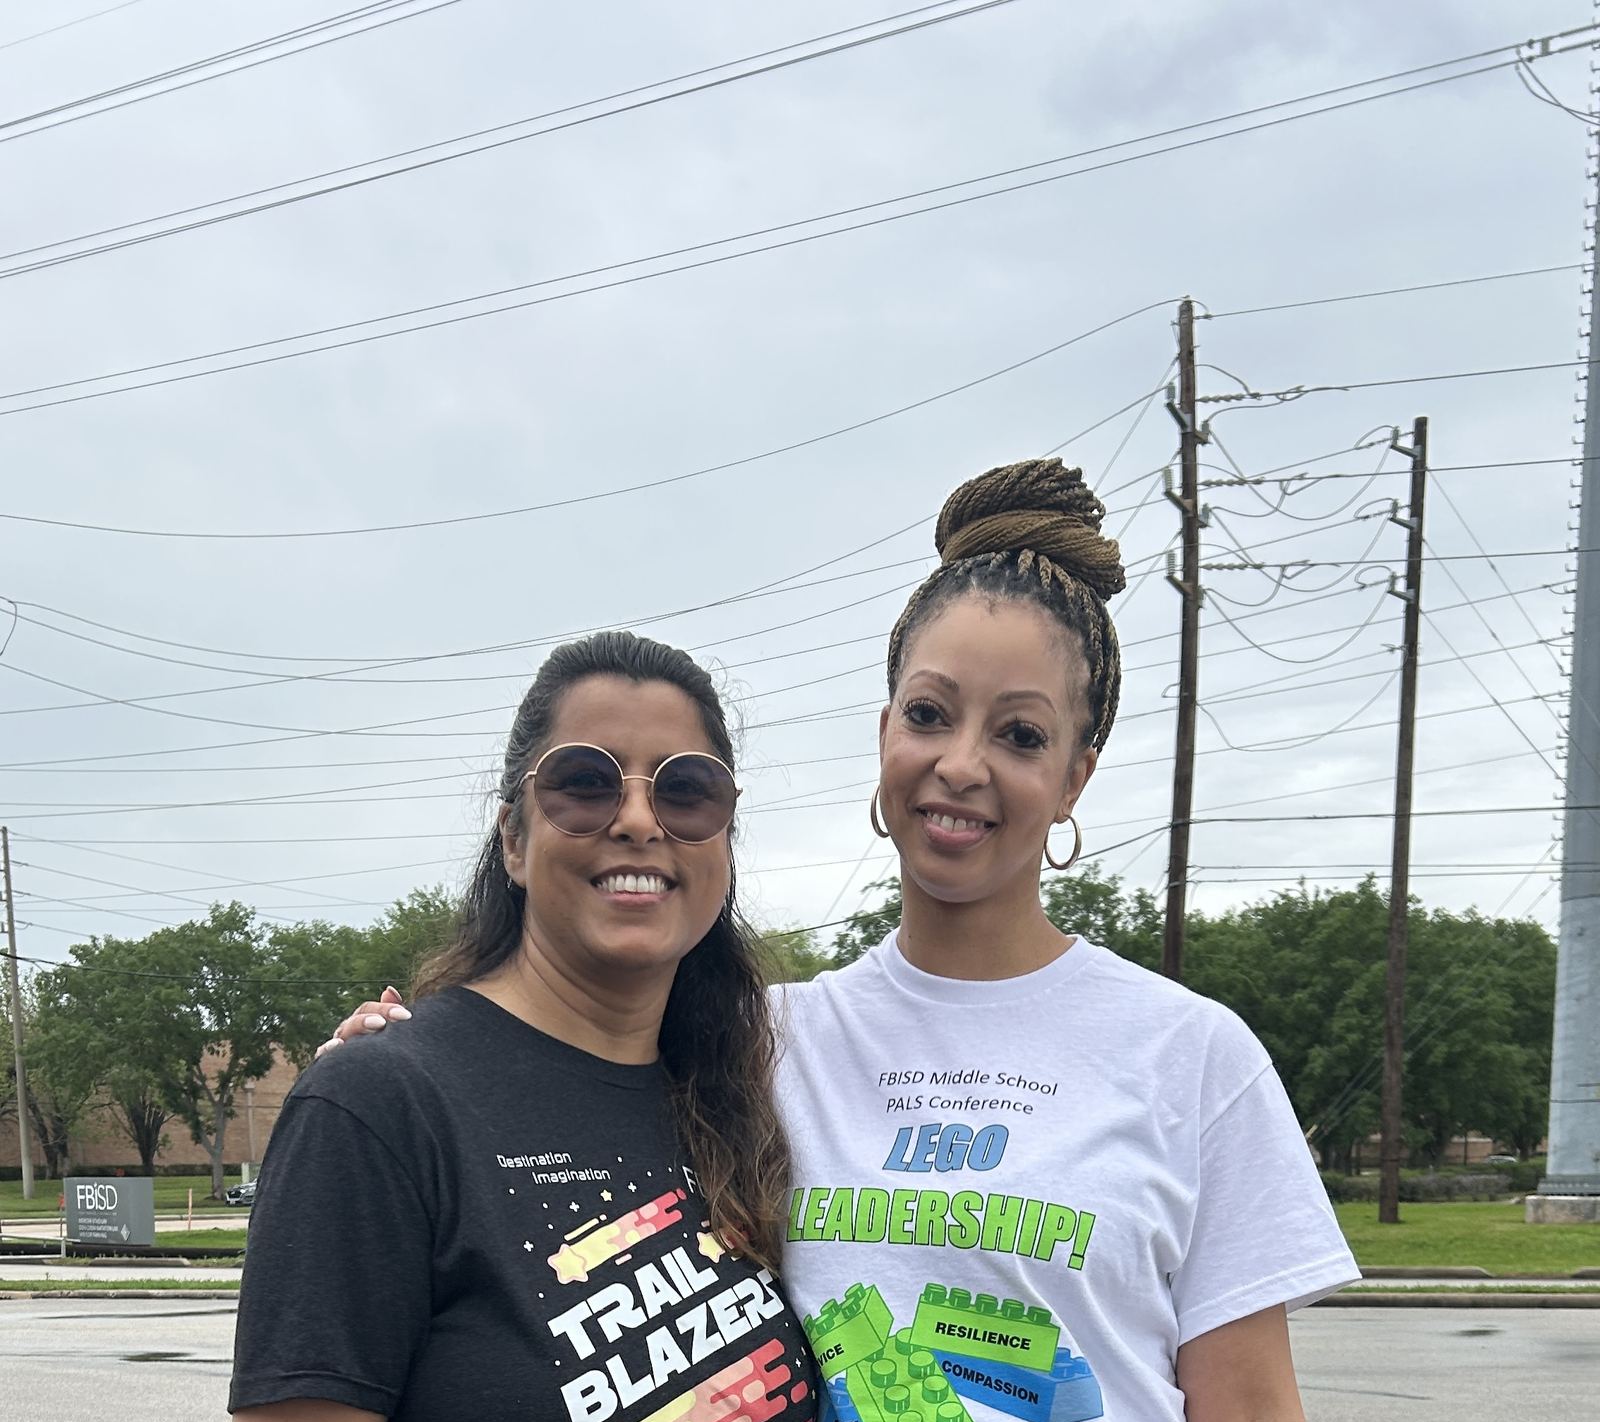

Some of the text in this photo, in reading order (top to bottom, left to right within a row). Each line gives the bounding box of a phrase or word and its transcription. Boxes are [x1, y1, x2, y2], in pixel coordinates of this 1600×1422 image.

[879, 1069, 1059, 1097] FBISD Middle School
[886, 1095, 1034, 1115] PALS Conference
[496, 1151, 573, 1168] Destination
[882, 1122, 1010, 1173] LEGO
[532, 1167, 611, 1185] Imagination
[786, 1187, 1097, 1271] LEADERSHIP!
[547, 1246, 720, 1361] TRAIL
[935, 1321, 1032, 1351] RESILIENCE
[941, 1360, 1039, 1405] COMPASSION
